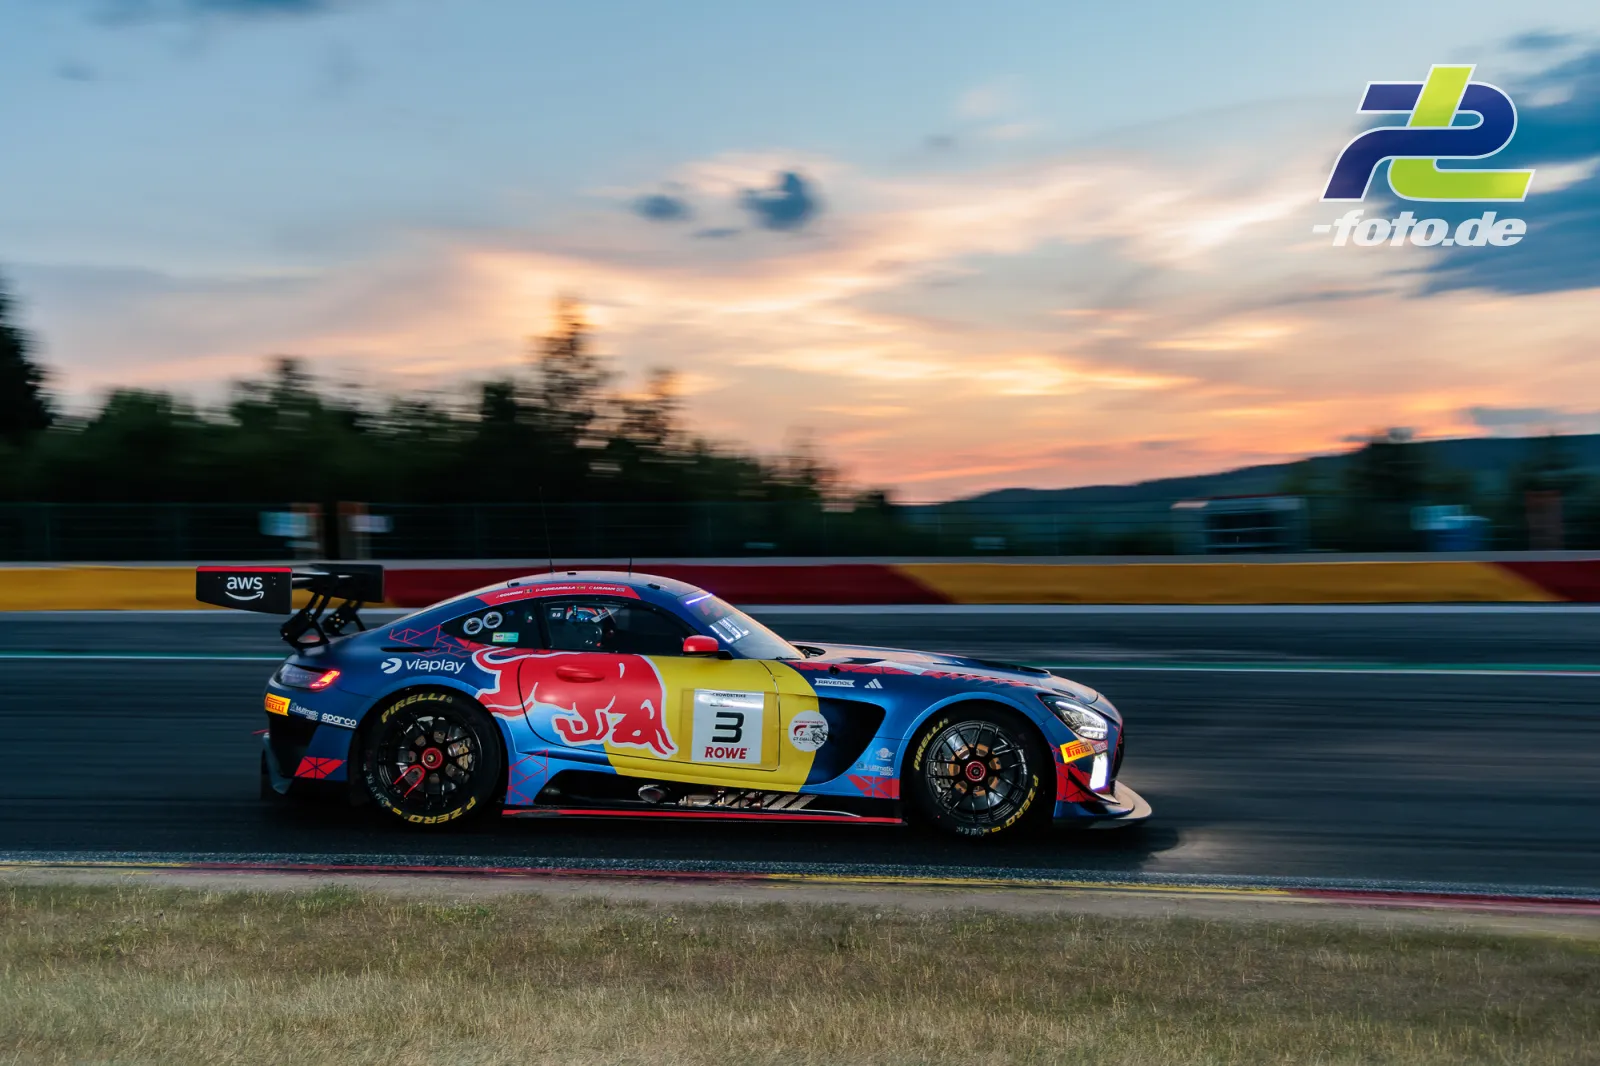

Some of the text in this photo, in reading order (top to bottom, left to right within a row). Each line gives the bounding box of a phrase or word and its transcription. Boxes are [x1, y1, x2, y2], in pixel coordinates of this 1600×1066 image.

[226, 576, 264, 590] aws
[406, 658, 466, 674] viaplay
[381, 693, 447, 723] PIRELLI
[321, 712, 357, 727] sparco
[711, 711, 745, 743] 3
[704, 746, 748, 760] ROWE
[914, 721, 944, 771] PIRELLI
[1065, 742, 1092, 758] PIRELLI
[1006, 787, 1036, 827] ZERO
[408, 807, 463, 824] ZERO
